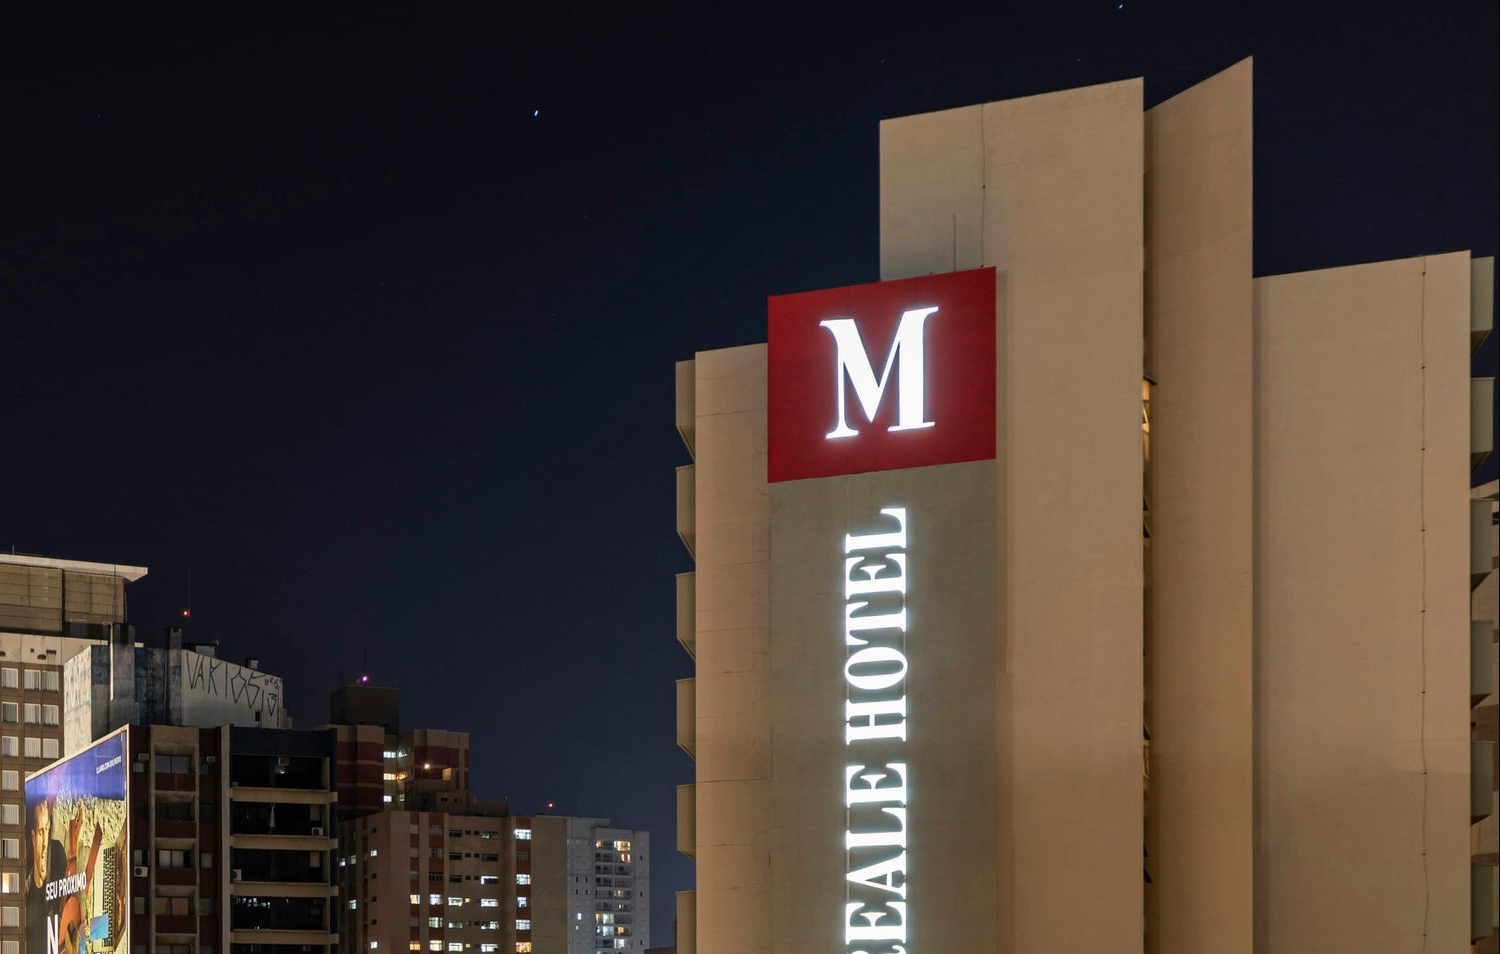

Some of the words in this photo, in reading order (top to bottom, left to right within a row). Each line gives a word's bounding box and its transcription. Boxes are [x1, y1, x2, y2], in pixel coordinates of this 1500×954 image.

[820, 305, 940, 441] M
[844, 506, 908, 745] HOTEL
[45, 880, 58, 901] SEU
[58, 871, 87, 898] PRÓXIMO
